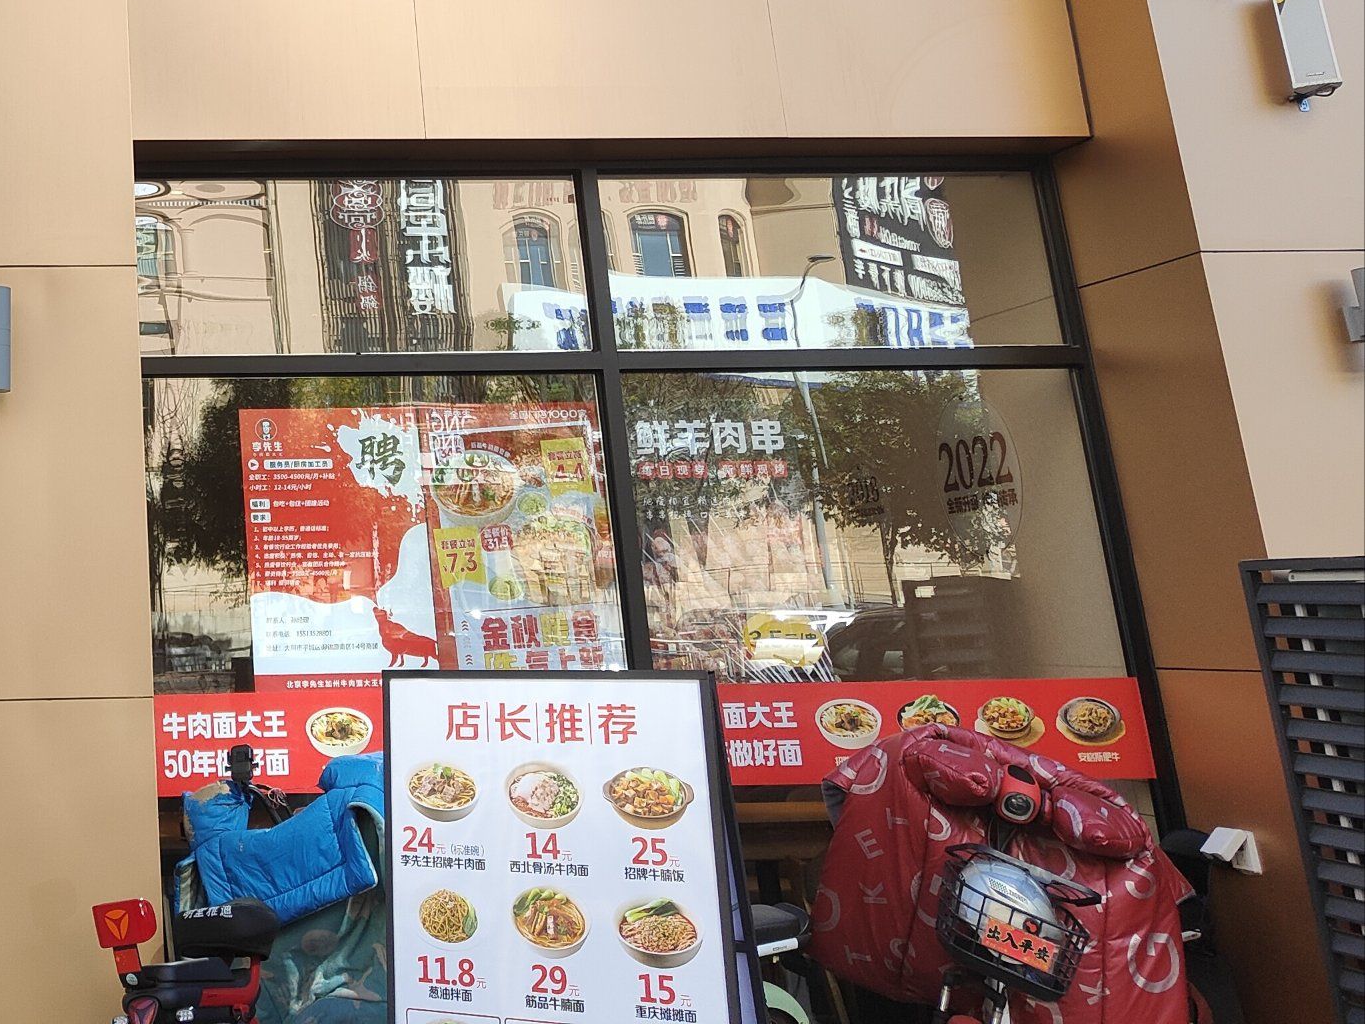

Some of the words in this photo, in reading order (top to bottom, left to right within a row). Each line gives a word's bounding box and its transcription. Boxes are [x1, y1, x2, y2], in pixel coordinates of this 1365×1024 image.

[251, 441, 283, 453] 李先生
[636, 418, 785, 457] 鲜羊肉串
[355, 432, 406, 487] 聘
[938, 431, 1014, 493] 2022
[162, 710, 288, 740] 牛肉面大王
[445, 701, 638, 745] 店长推荐
[722, 700, 798, 730] 面大王
[725, 739, 804, 768] 做好面
[399, 854, 487, 872] 李先生招牌牛肉面
[509, 860, 590, 878] 西北骨汤牛肉面
[624, 867, 686, 883] 招牌牛腩饭
[986, 925, 1051, 964] 出入平安
[428, 985, 473, 1003] 葱油拌面
